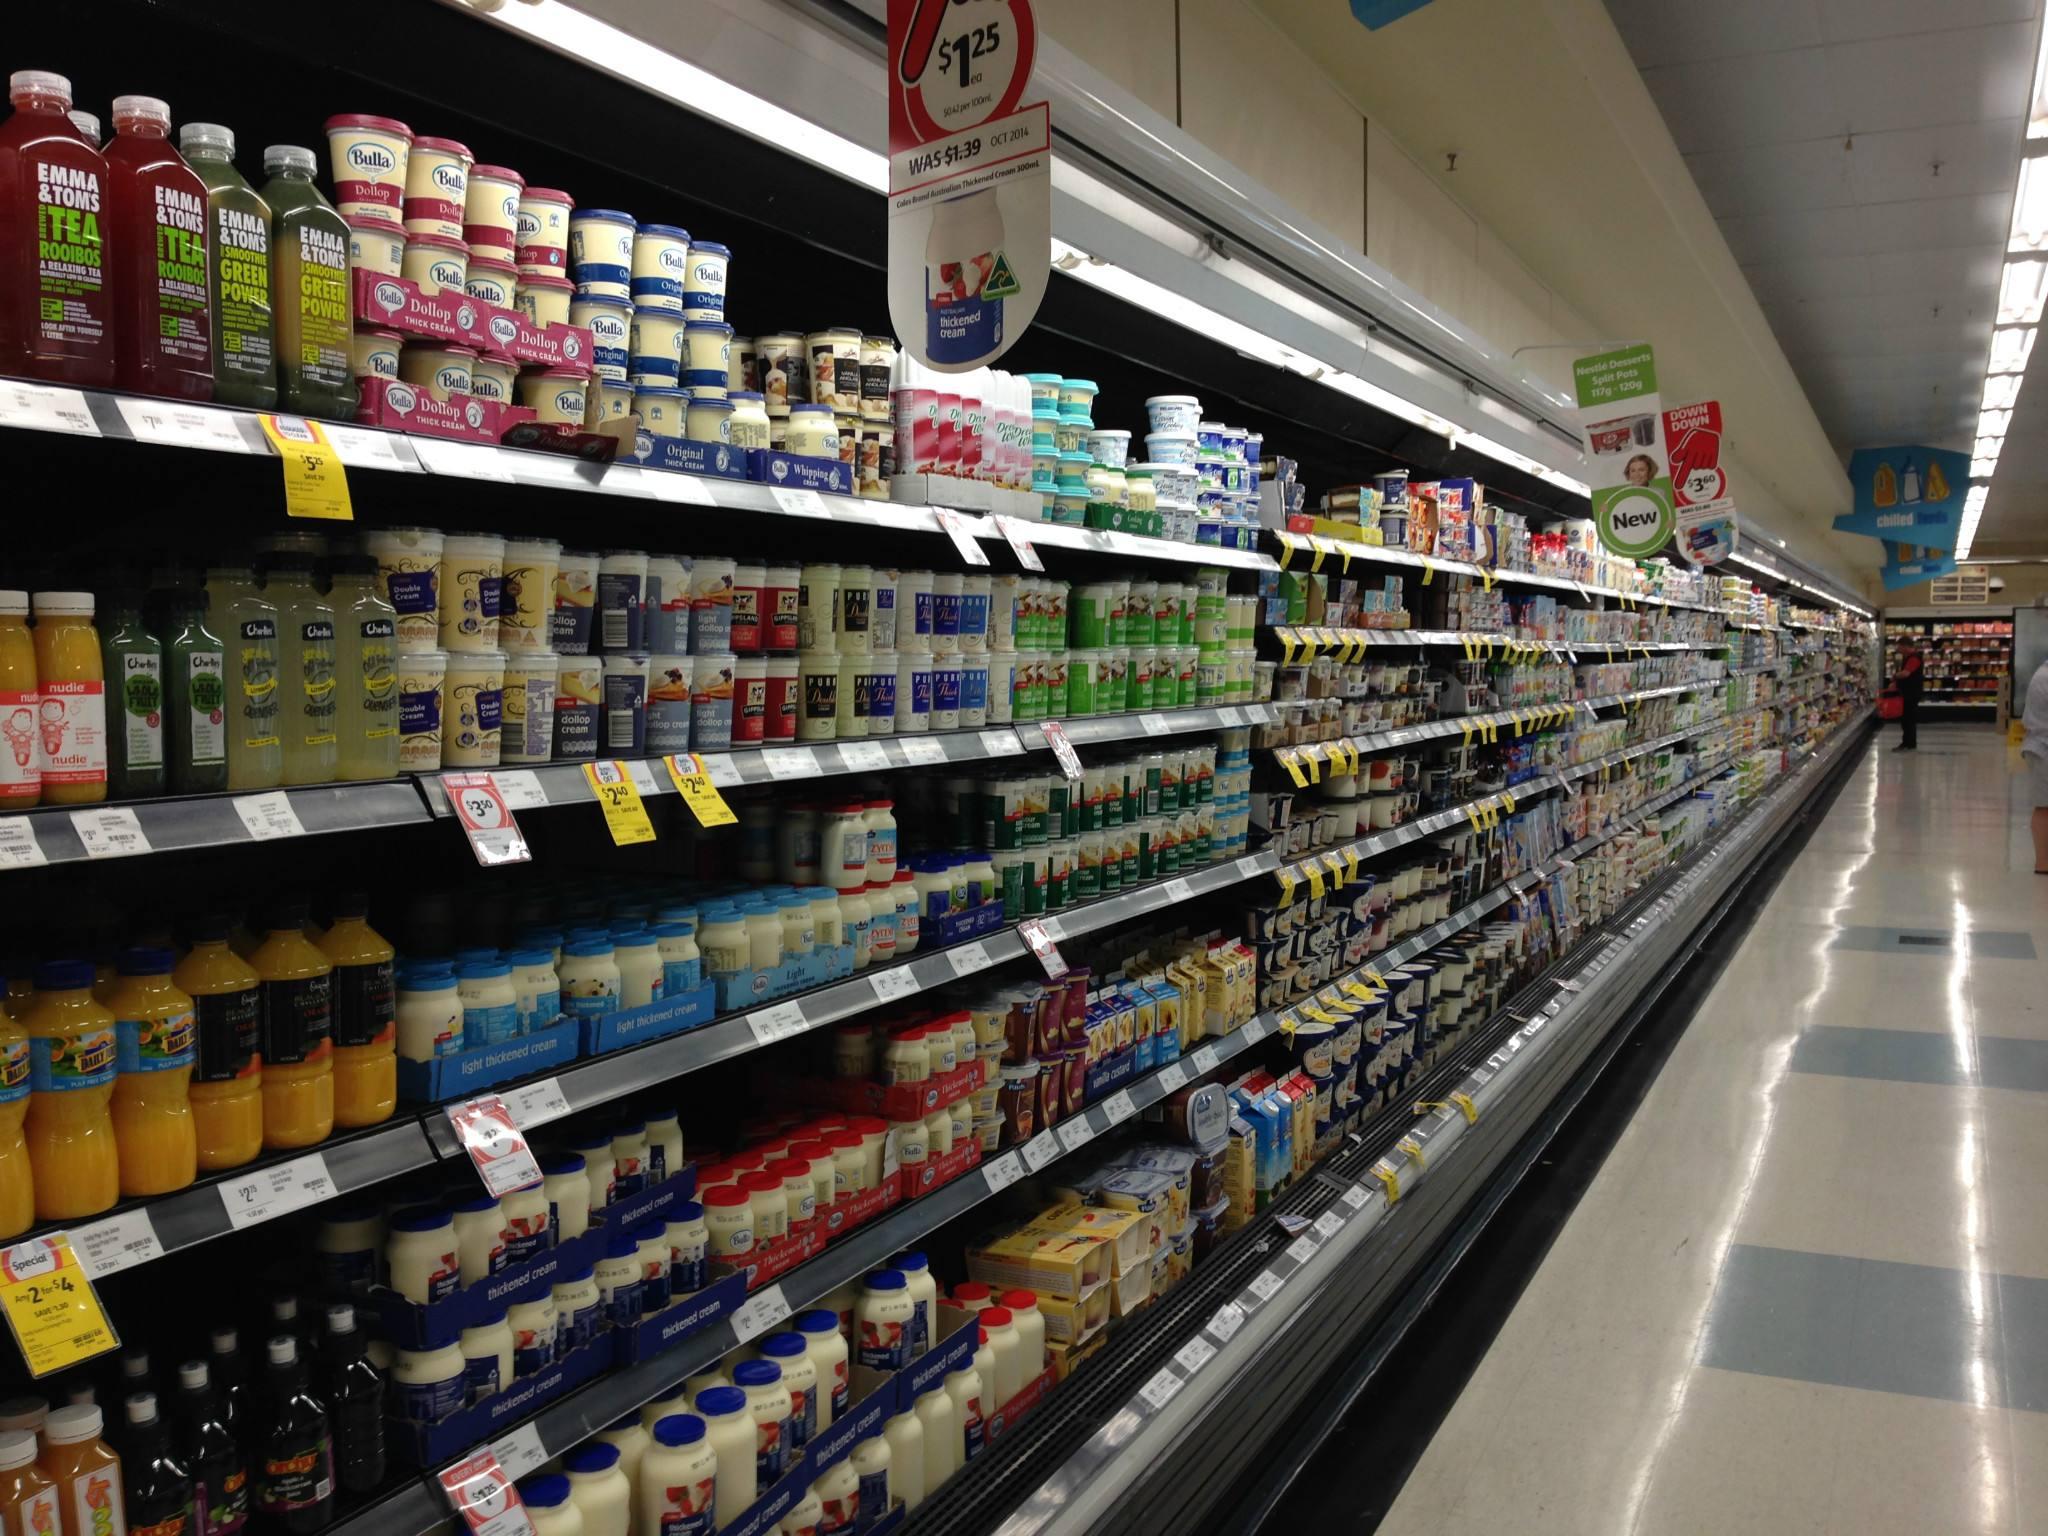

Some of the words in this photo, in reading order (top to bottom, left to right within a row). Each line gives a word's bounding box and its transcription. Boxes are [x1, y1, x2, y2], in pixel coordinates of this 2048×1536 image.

[351, 148, 392, 169] Bulla
[909, 152, 942, 176] WAS
[944, 138, 981, 167] $1.39
[990, 136, 1008, 148] OCT
[1009, 128, 1029, 143] 2014
[37, 162, 99, 193] EMMA
[912, 192, 930, 204] Brand
[930, 183, 962, 200] Australian
[962, 174, 994, 189] Thickened
[995, 168, 1016, 179] Cream
[155, 185, 202, 216] EMMA
[355, 184, 390, 201] Dollop
[47, 205, 103, 248] TEA
[219, 208, 266, 236] EMMA
[163, 227, 205, 267] TEA
[300, 225, 345, 253] EMMA
[40, 240, 102, 269] ROOIBOS
[225, 246, 267, 266] SMOOTHIE
[48, 262, 85, 276] RELAXING
[158, 260, 205, 287] ROOIBOS
[220, 259, 268, 288] GREEN
[305, 262, 346, 282] SMOOTHIE
[165, 280, 196, 293] RELAXING
[221, 281, 268, 306] POWER
[301, 275, 346, 304] GREEN
[301, 296, 346, 322] POWER
[410, 298, 451, 322] Dollop
[940, 310, 981, 328] thickened
[404, 315, 430, 329] THICK
[430, 321, 456, 335] CREAM
[492, 319, 516, 338] Bulla
[593, 319, 624, 336] Bulla
[940, 327, 966, 339] cream
[520, 331, 558, 352] Dollop
[516, 346, 538, 358] THICK
[540, 351, 563, 364] CREAM
[1609, 353, 1651, 370] Desserts
[1592, 373, 1615, 386] Split
[1616, 368, 1639, 381] Pots
[1619, 380, 1643, 394] 120g
[388, 391, 413, 408] Bulla
[420, 398, 461, 419] Dollop
[1669, 404, 1708, 422] DOWN
[415, 416, 440, 427] THICK
[440, 419, 466, 432] CREAM
[1671, 415, 1709, 432] DOWN
[667, 444, 704, 461] Original
[664, 458, 684, 469] THICK
[684, 461, 705, 471] CREAM
[793, 464, 829, 481] Whipping
[1612, 509, 1657, 531] New
[393, 583, 422, 594] Double
[394, 592, 420, 602] Cream
[49, 683, 85, 693] nudie
[399, 711, 425, 721] Cream
[400, 704, 426, 714] Double
[561, 714, 591, 727] dollop
[561, 725, 589, 734] cream
[52, 754, 87, 765] nudie
[786, 966, 806, 982] Light
[616, 1017, 635, 1034] light
[635, 1006, 674, 1029] thickened
[674, 1001, 697, 1018] cream
[461, 1055, 483, 1075] light
[484, 1042, 529, 1070] thickened
[530, 1037, 558, 1056] cream
[1092, 1072, 1110, 1089] vanilla
[1110, 1061, 1131, 1080] custard
[621, 1202, 652, 1225] thickened
[652, 1191, 674, 1208] cream
[12, 1252, 48, 1272] Special
[487, 1271, 530, 1301] thickened
[531, 1260, 558, 1280] cream
[28, 1286, 43, 1304] 2
[662, 1312, 698, 1340] thickened
[698, 1300, 721, 1320] cream
[912, 1355, 947, 1391] thickened
[947, 1341, 968, 1365] cream
[490, 1390, 535, 1418] thickened
[536, 1372, 563, 1393] cream
[816, 1423, 856, 1467] thickened
[856, 1405, 882, 1432] cream
[761, 1490, 790, 1521] cream
